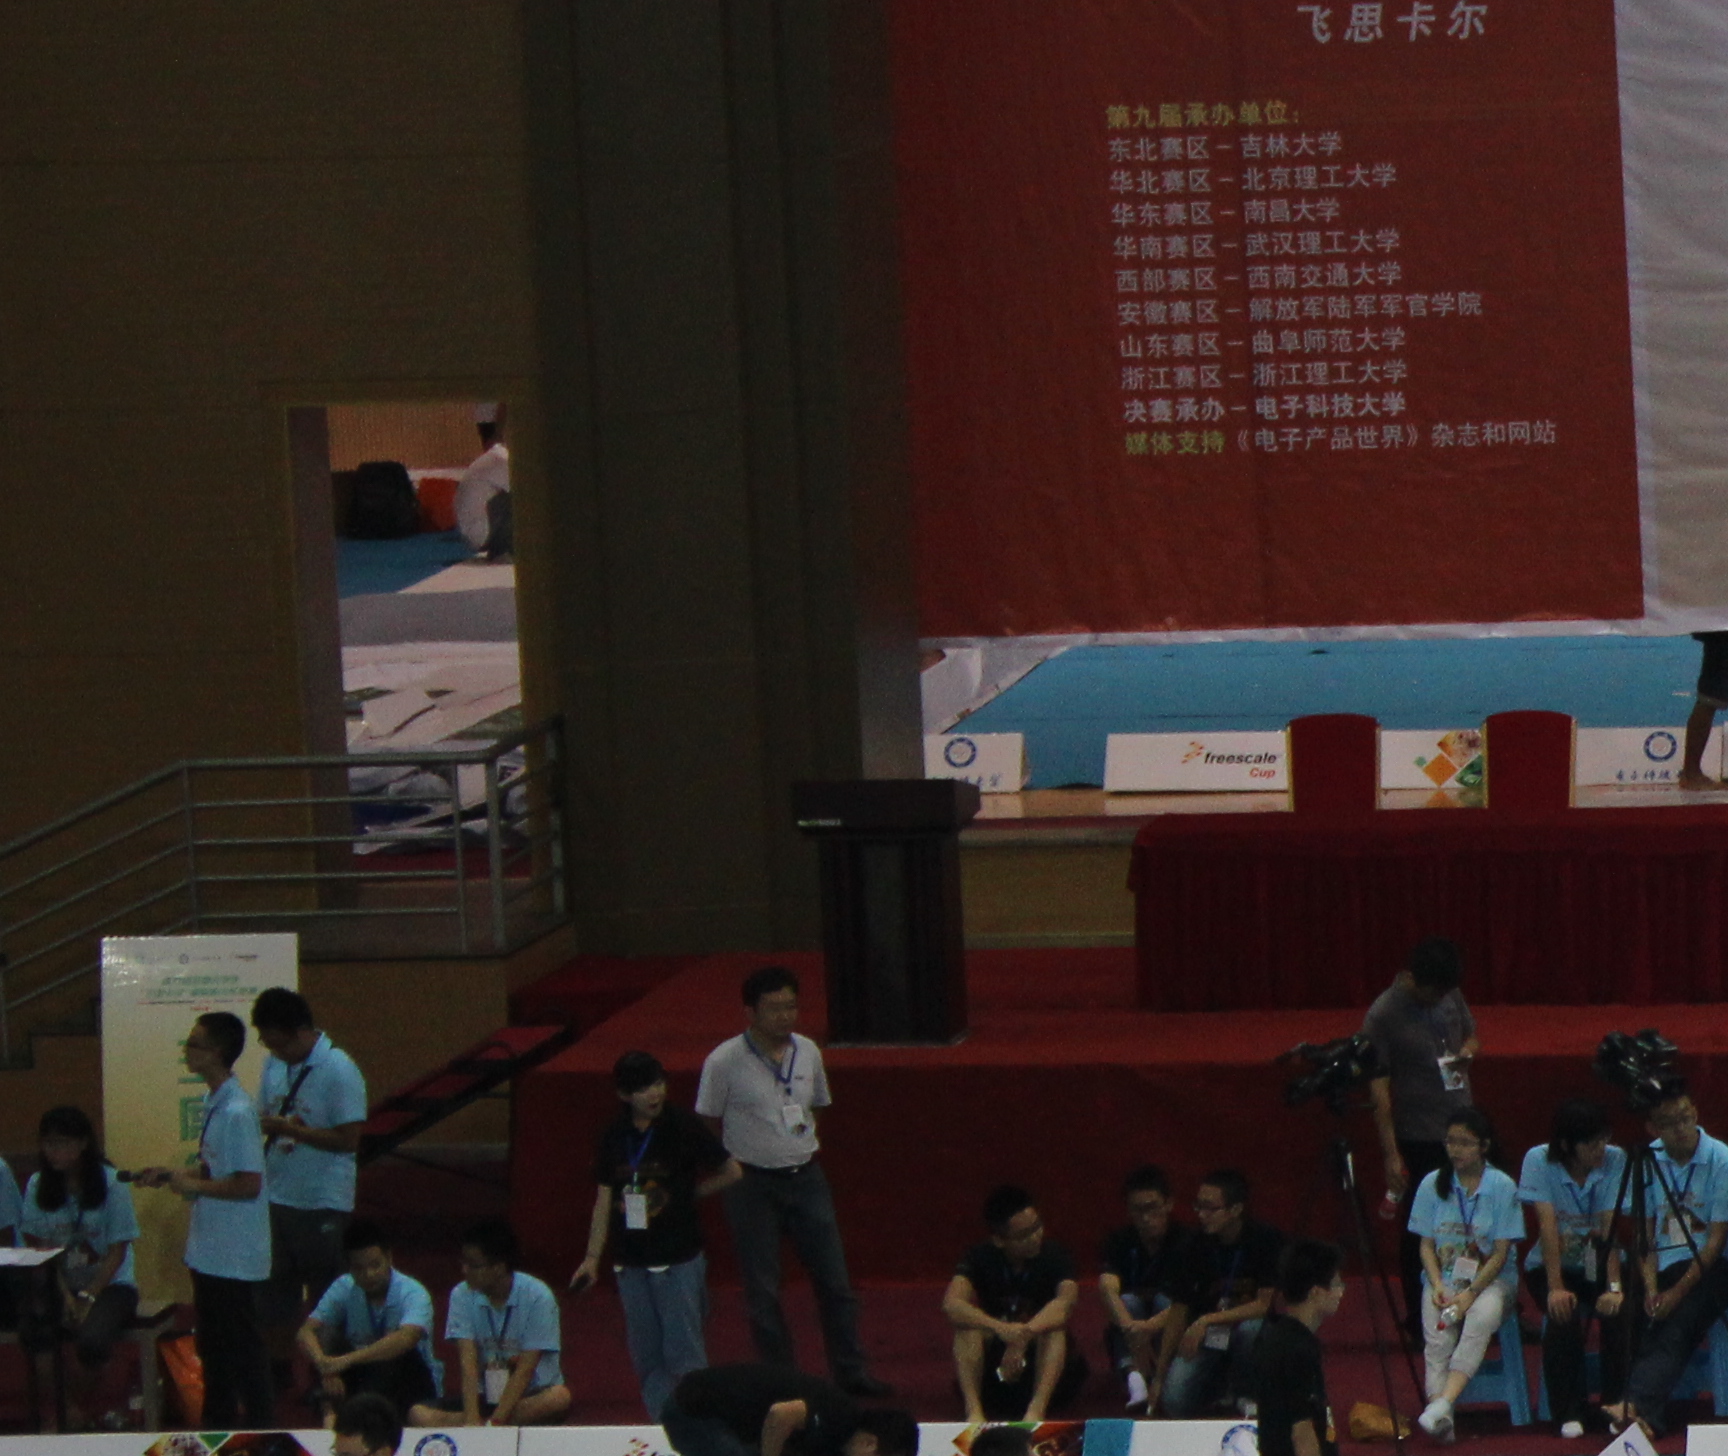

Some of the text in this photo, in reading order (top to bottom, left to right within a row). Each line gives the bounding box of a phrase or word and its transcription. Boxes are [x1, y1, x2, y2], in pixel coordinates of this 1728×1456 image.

[1297, 1, 1488, 43] 飞思卡尔
[1204, 750, 1277, 766] freescale
[1249, 767, 1276, 779] Cup
